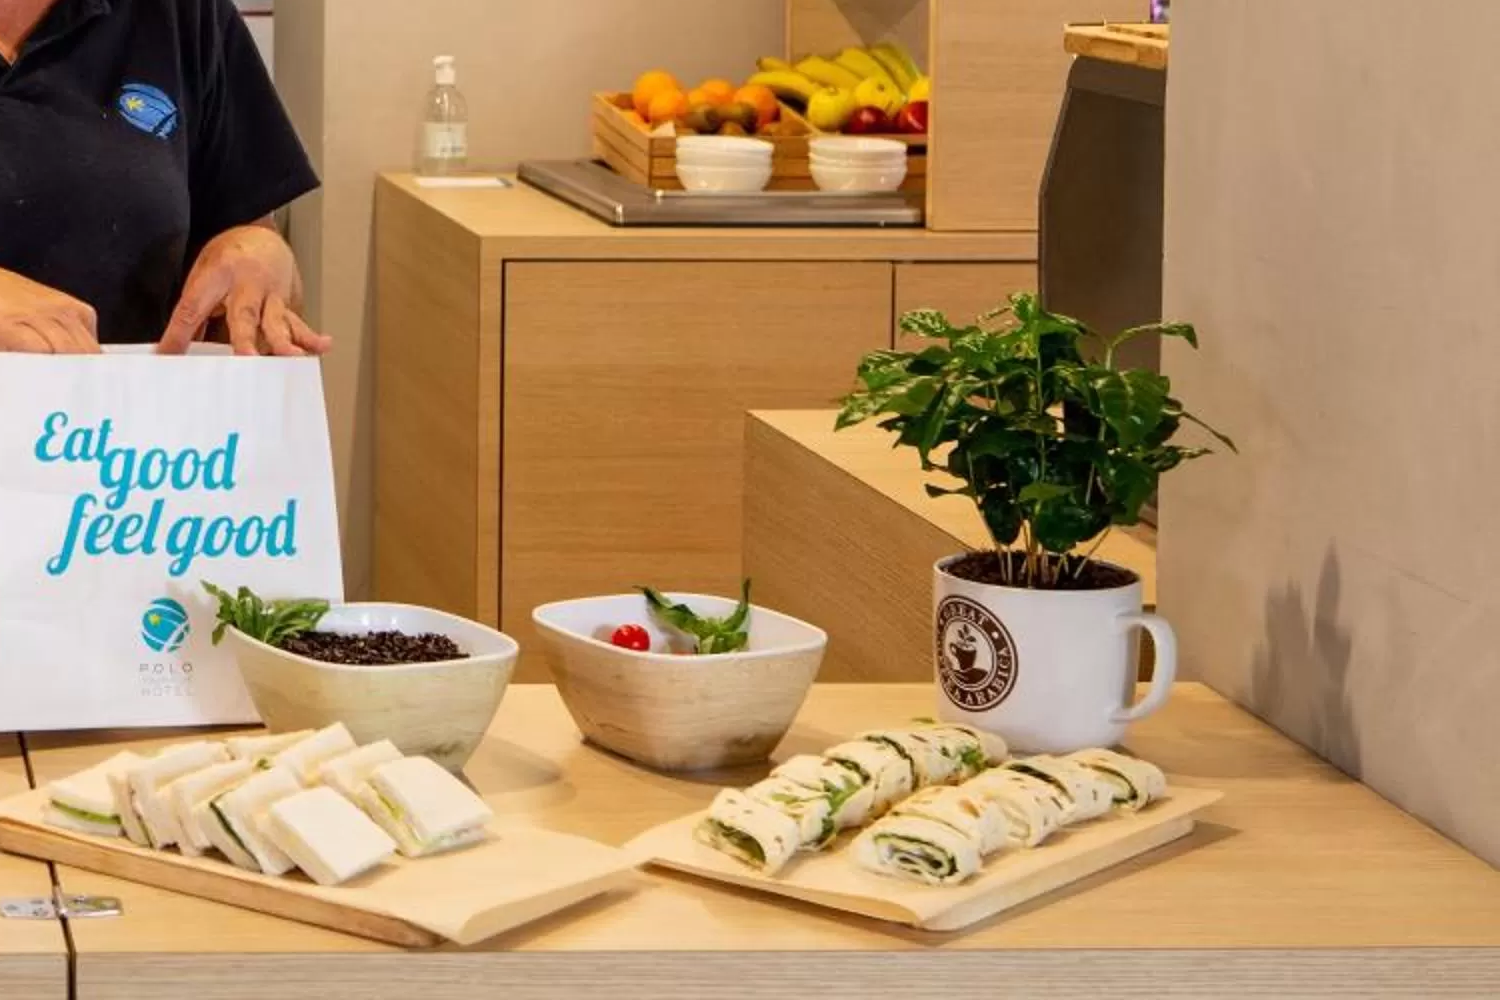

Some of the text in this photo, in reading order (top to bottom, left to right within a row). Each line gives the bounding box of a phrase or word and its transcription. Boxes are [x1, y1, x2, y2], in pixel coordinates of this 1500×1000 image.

[34, 411, 240, 511] Eat good
[46, 493, 297, 578] feel good
[139, 662, 194, 675] POLO
